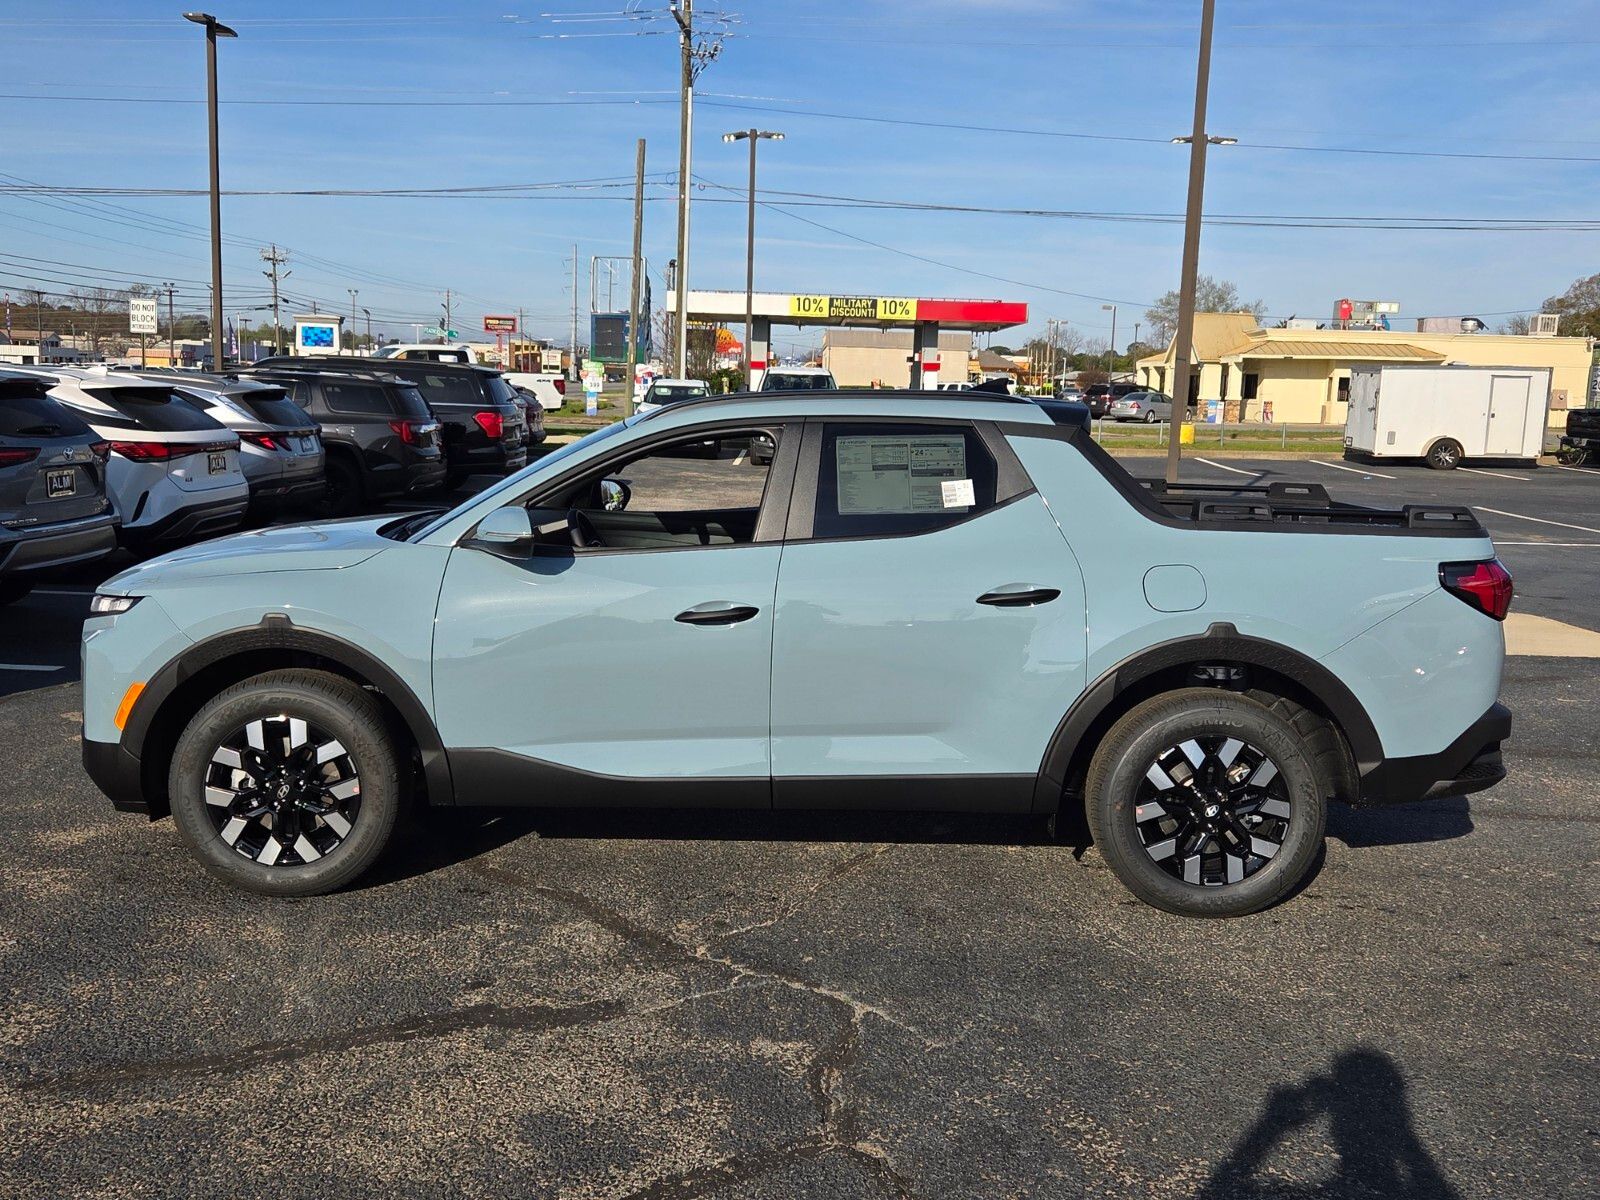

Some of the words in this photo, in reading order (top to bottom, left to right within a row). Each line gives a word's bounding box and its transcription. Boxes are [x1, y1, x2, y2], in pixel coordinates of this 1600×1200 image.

[131, 303, 140, 311] DO
[142, 304, 155, 312] NOT
[796, 297, 824, 313] 10%
[833, 298, 873, 309] MILITARY
[882, 300, 910, 315] 10%
[131, 314, 155, 323] BLOCK
[830, 307, 875, 318] DISCOUNT!
[212, 456, 225, 469] ALM
[52, 475, 71, 490] ALM
